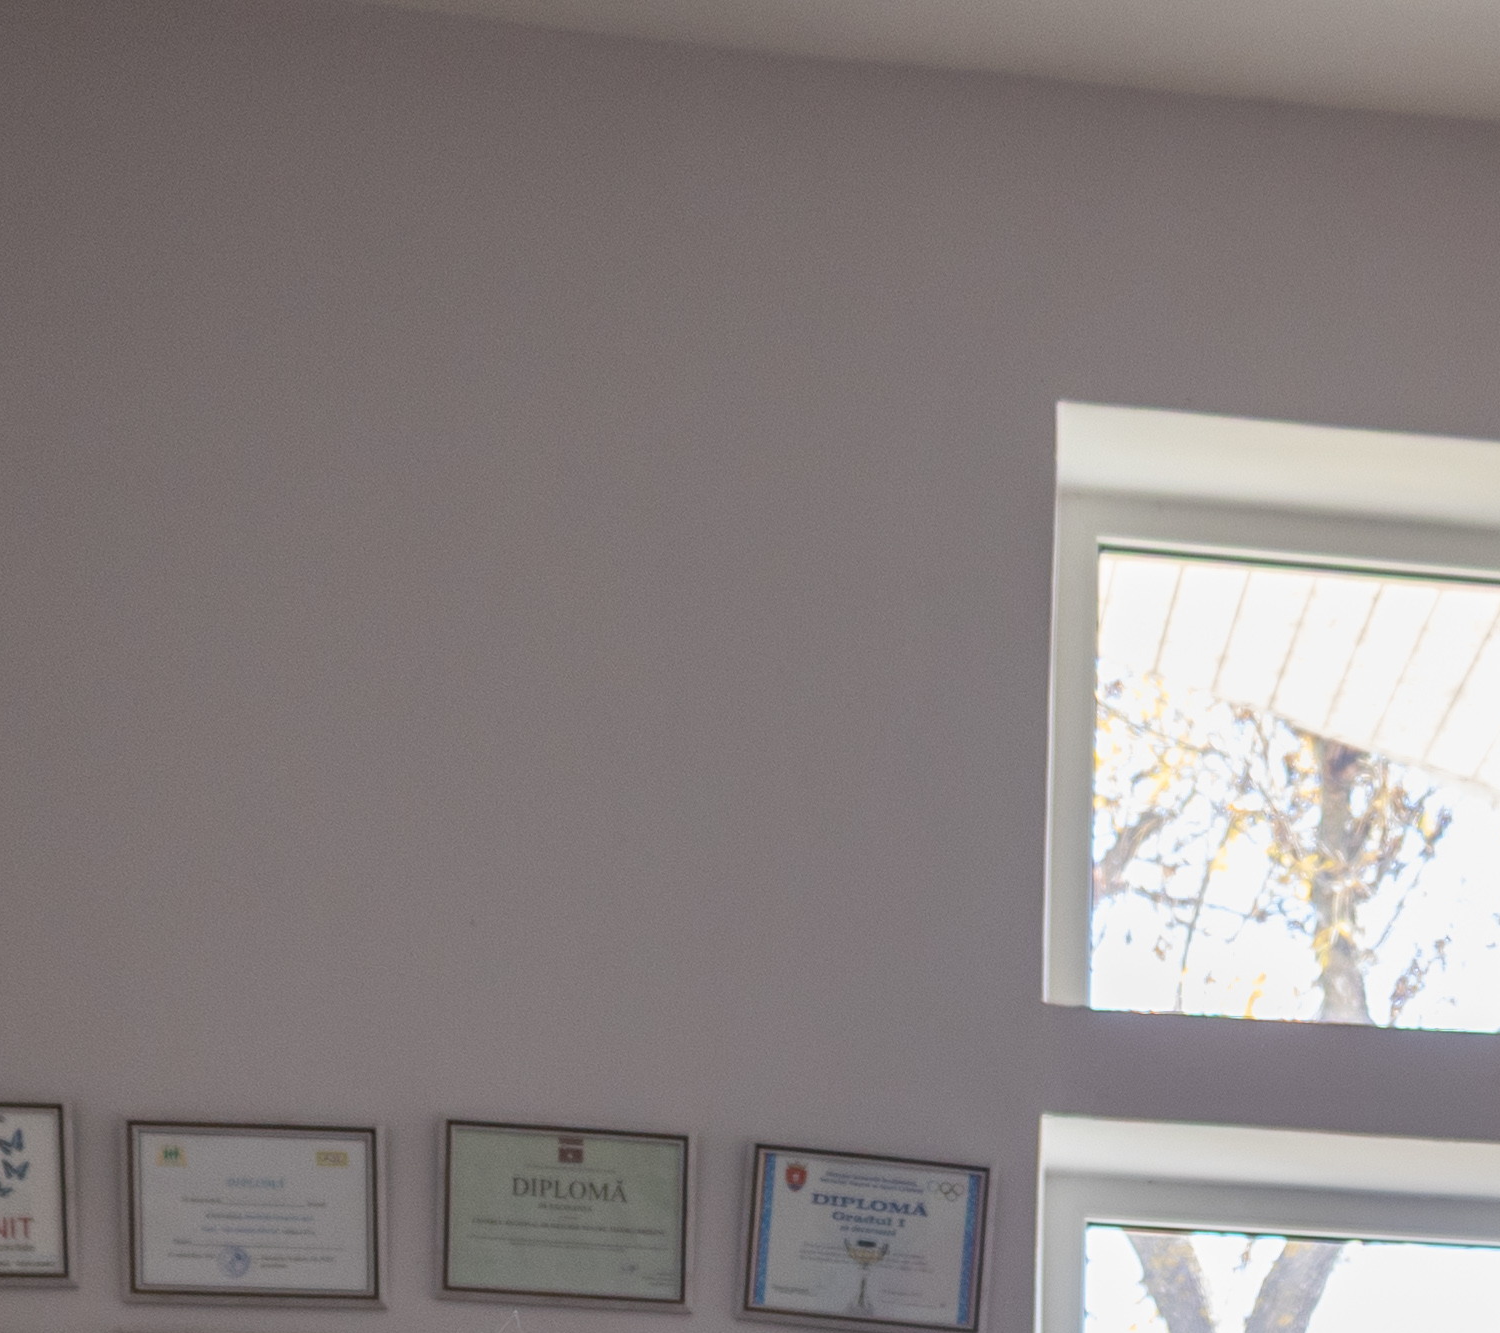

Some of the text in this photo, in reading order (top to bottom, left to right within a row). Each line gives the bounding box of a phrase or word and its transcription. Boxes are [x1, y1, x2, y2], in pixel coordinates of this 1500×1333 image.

[512, 1177, 628, 1204] DIPLOMĂ
[811, 1192, 929, 1218] DIPLOMĂ
[832, 1211, 893, 1227] Gradul
